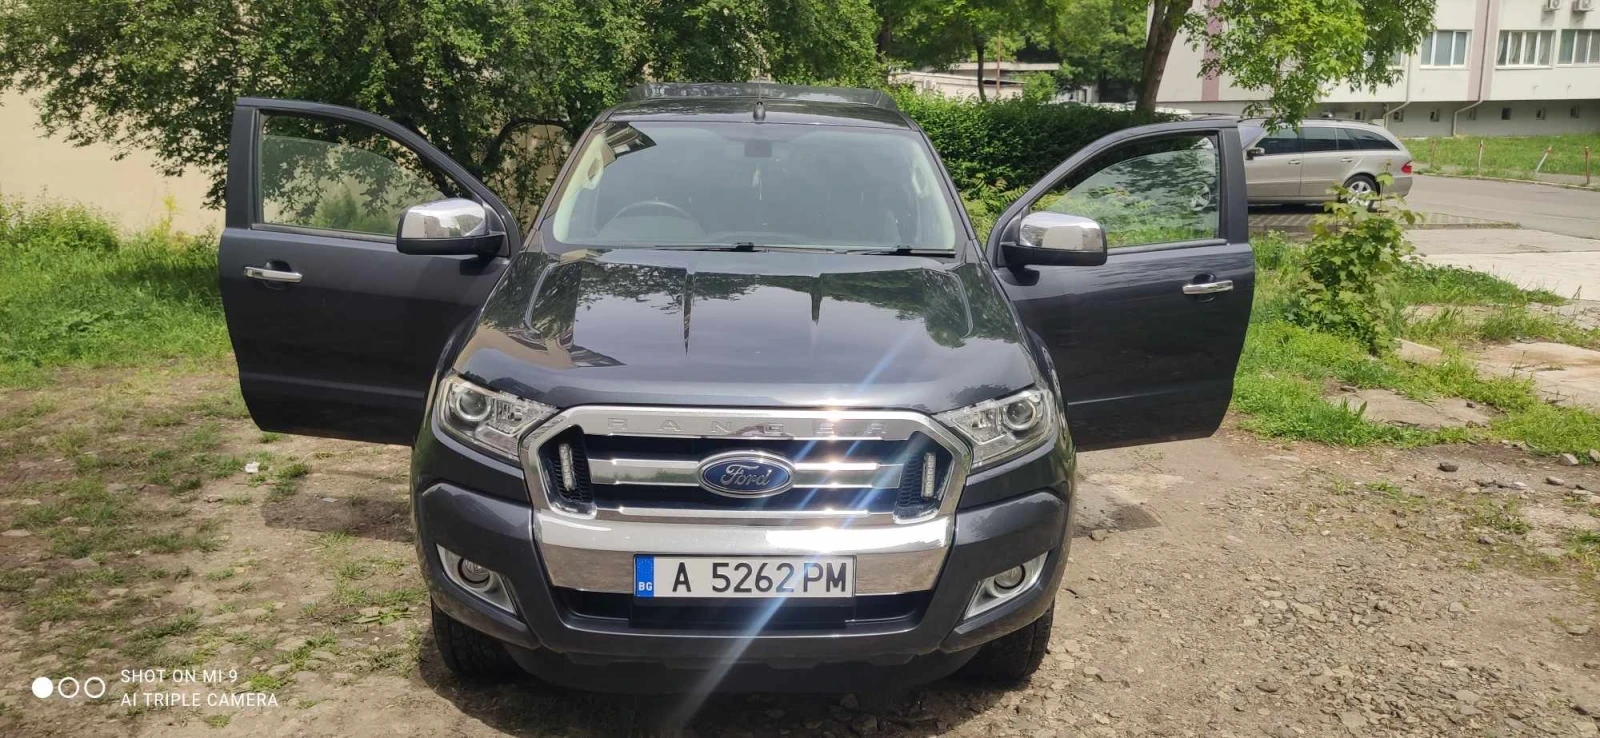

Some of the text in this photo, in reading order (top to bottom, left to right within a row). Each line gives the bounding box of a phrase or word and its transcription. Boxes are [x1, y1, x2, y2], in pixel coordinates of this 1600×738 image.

[607, 417, 888, 434] RANGER
[720, 464, 772, 486] Ford
[638, 582, 652, 591] BG
[672, 561, 847, 593] A 5262 PM
